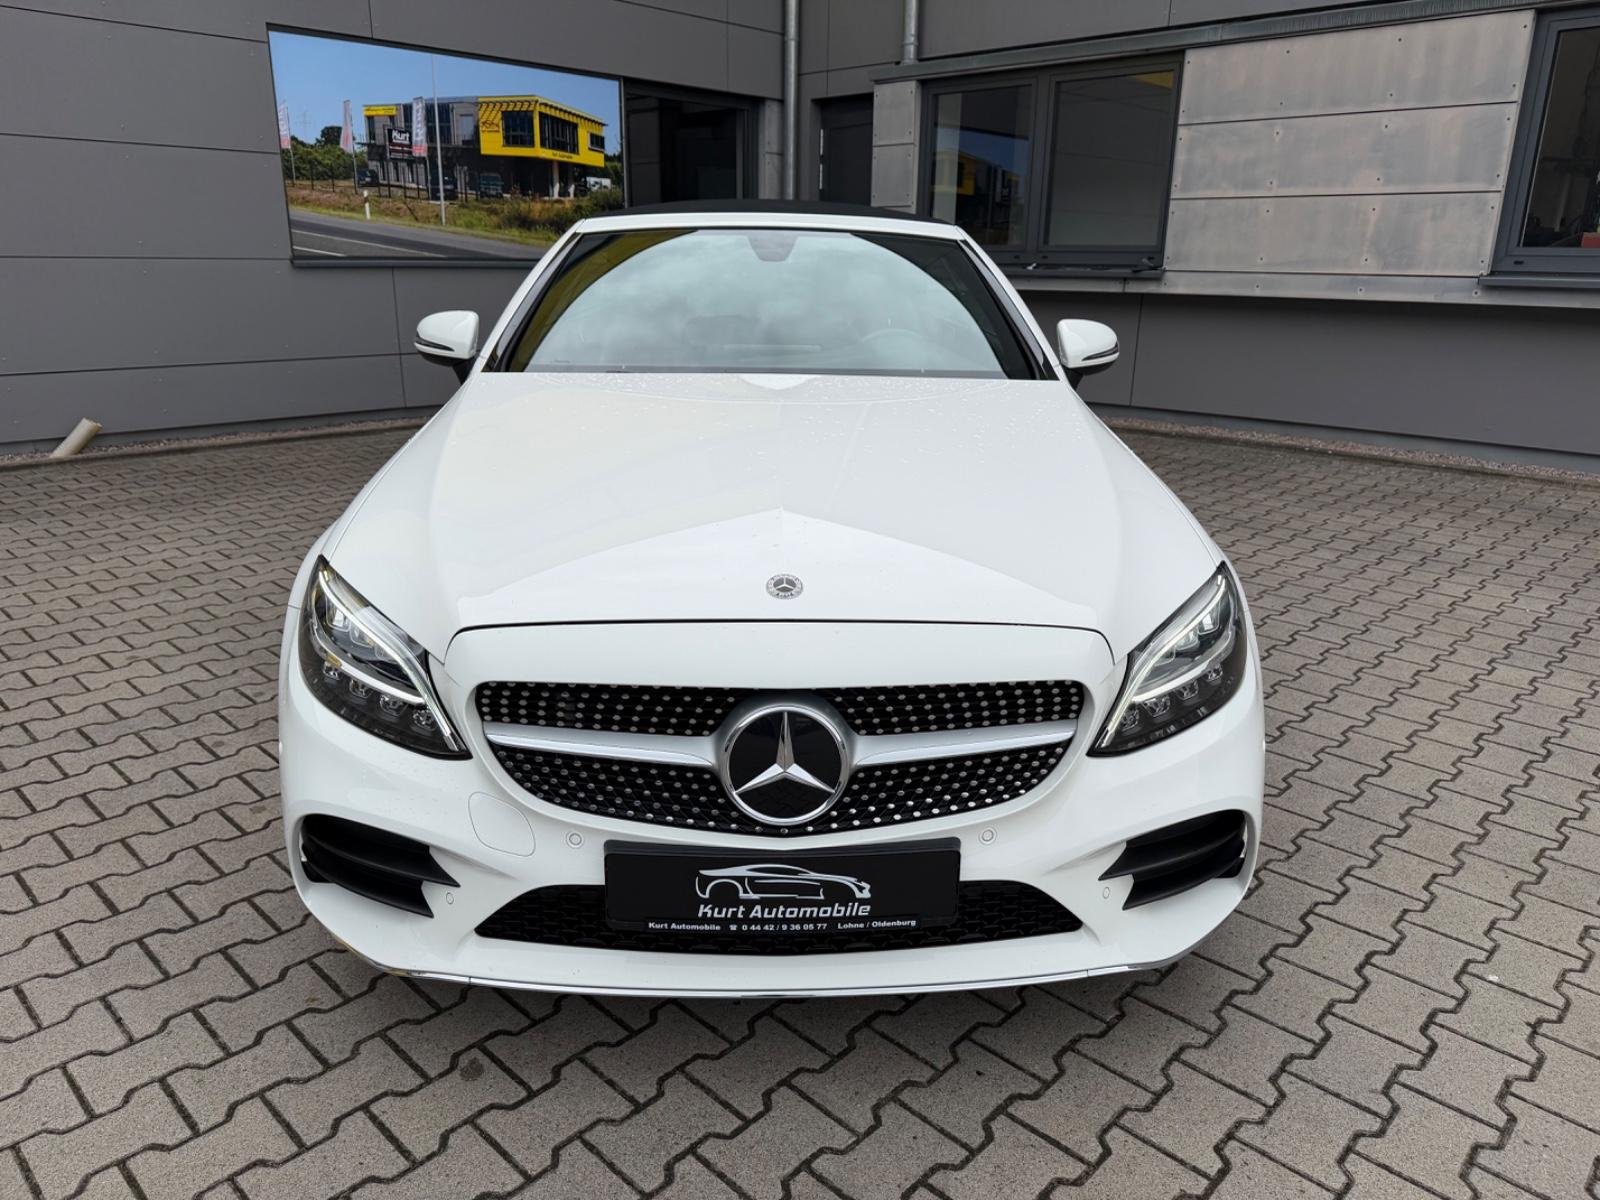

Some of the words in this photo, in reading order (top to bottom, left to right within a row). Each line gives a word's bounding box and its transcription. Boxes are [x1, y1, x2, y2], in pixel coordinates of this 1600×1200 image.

[698, 904, 745, 918] Kurt
[749, 902, 871, 918] Automobile
[670, 923, 721, 931] Automobile
[837, 922, 865, 930] Lohne
[871, 919, 917, 928] Oldenburg
